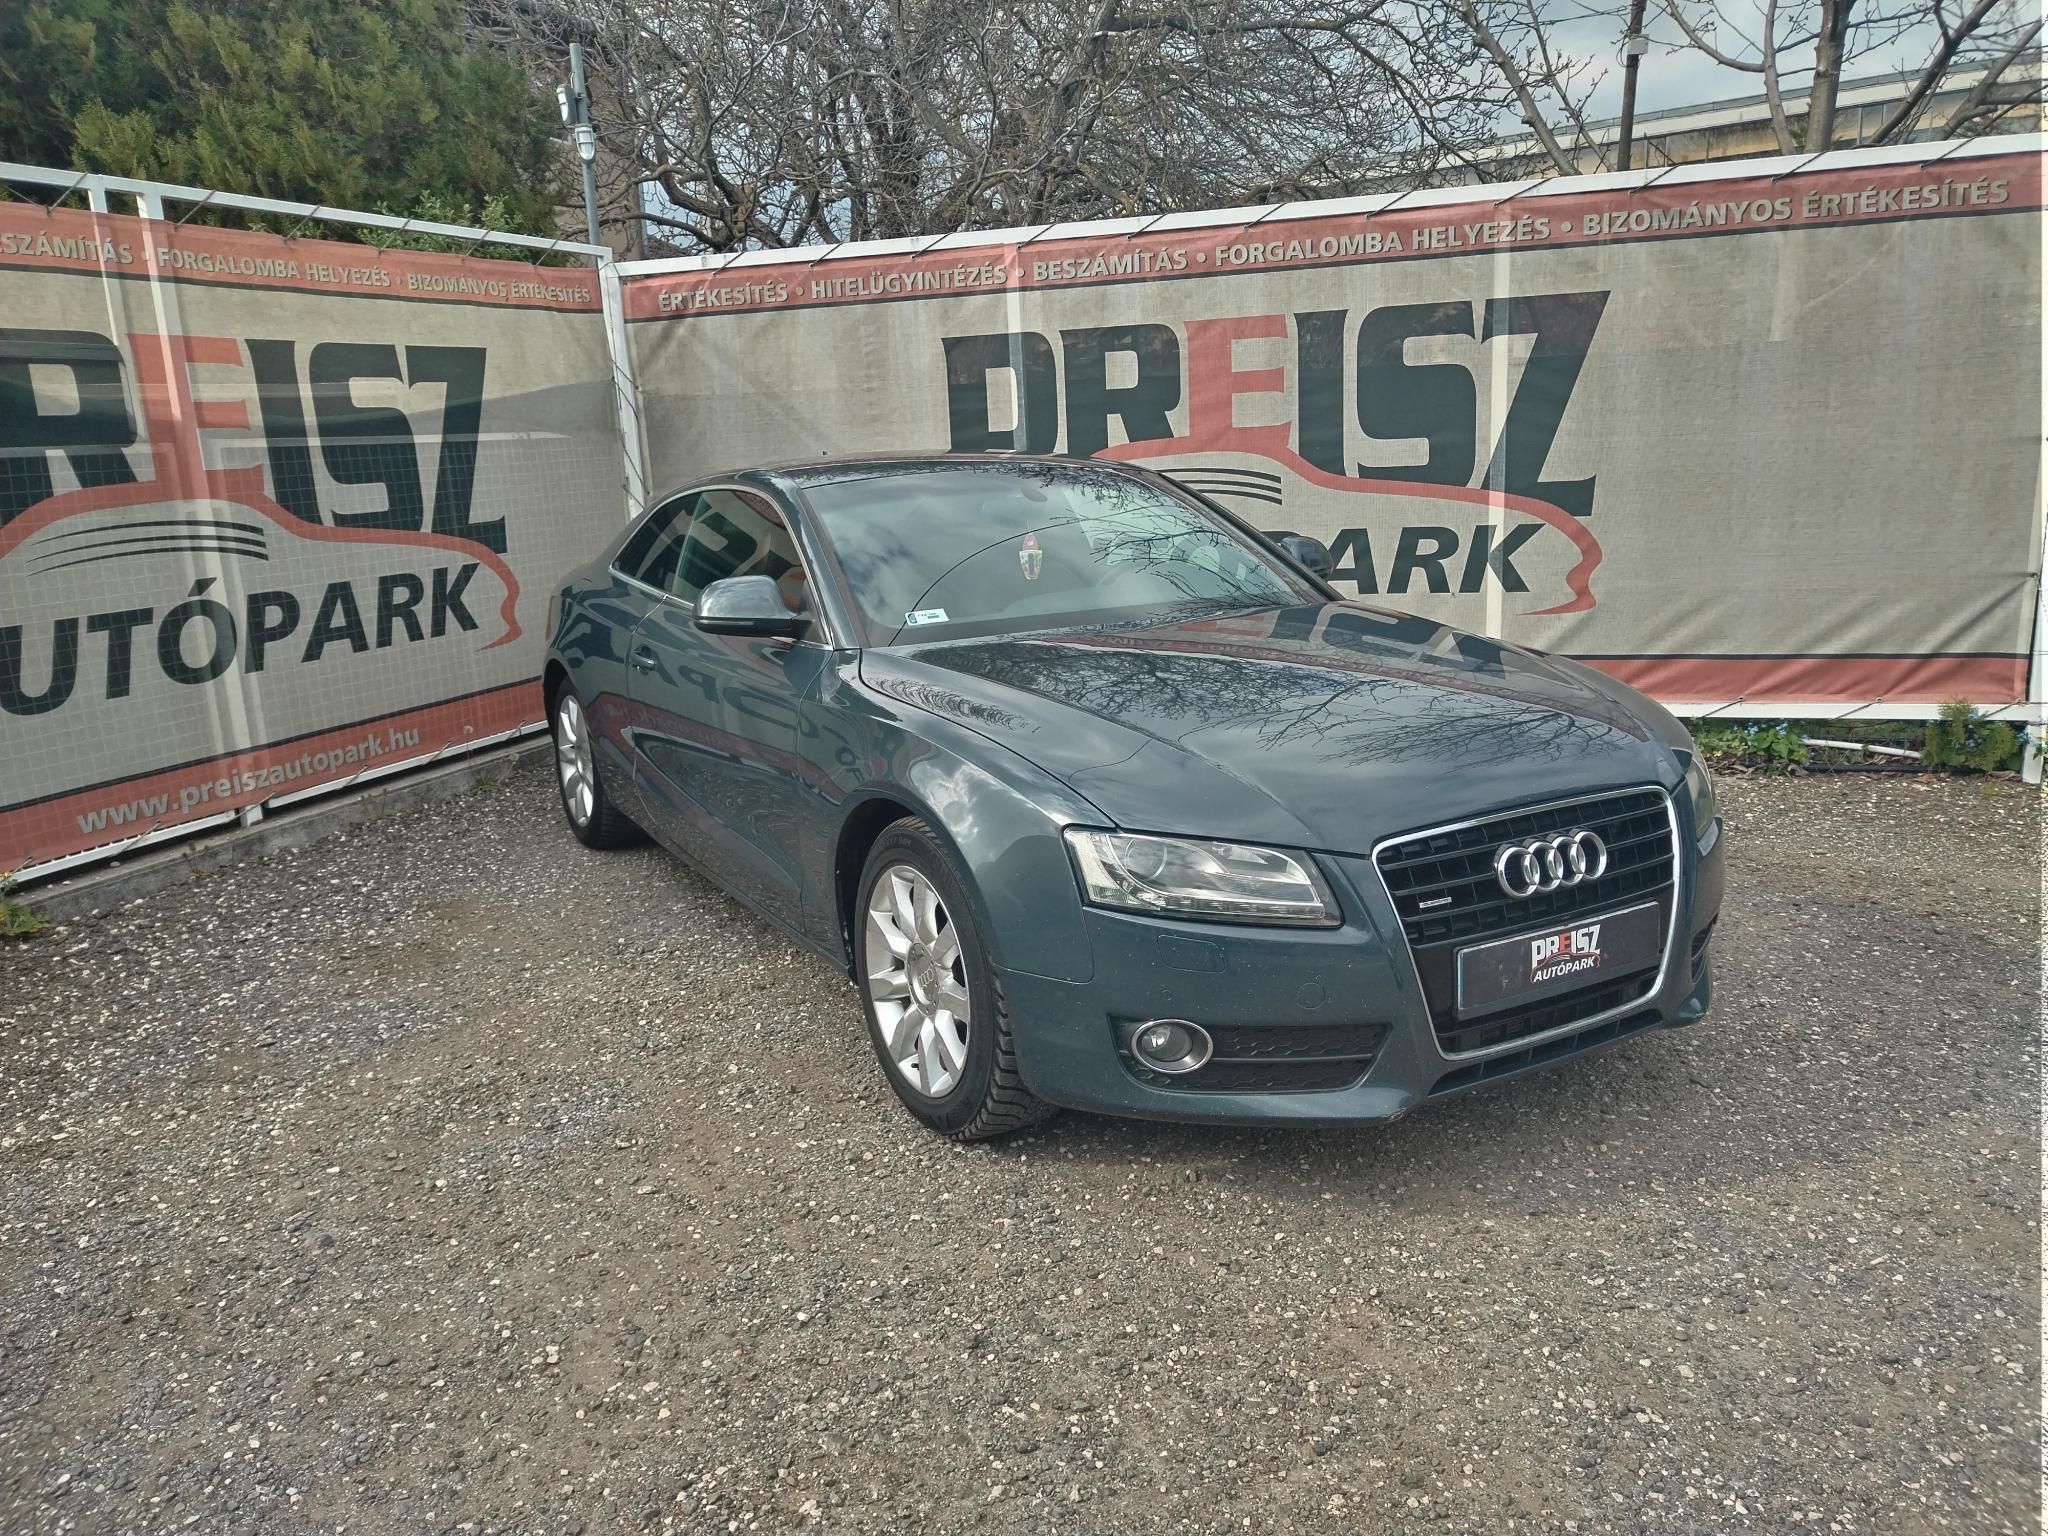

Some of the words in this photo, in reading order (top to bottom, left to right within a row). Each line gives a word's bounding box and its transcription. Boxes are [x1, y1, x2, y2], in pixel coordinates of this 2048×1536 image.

[0, 231, 133, 264] SZÁMÍTÁS
[157, 246, 301, 280] FORGALOMBA
[304, 263, 392, 288] HELYEZÉS
[407, 272, 509, 299] BIZOMÁNYOS
[511, 279, 592, 304] ÉRTÉKESÍTÉS
[658, 282, 788, 313] ÉRTÉKESÍTÉS
[811, 261, 1008, 300] HITELÜGYINTÉZÉS
[1032, 248, 1188, 282] BESZÁMÍTÁS
[1214, 231, 1404, 267] FORGALOMBA
[1411, 213, 1551, 251] HELYEZÉS
[1582, 195, 1793, 237] BIZOMÁNYOS
[1802, 177, 2010, 219] ÉRTÉKESÍTÉS
[1260, 522, 1546, 595] ARK
[76, 726, 421, 835] www.preiszautopark.hu
[1531, 924, 1601, 971] PREISZ
[1533, 955, 1596, 983] AUTÓPARK
